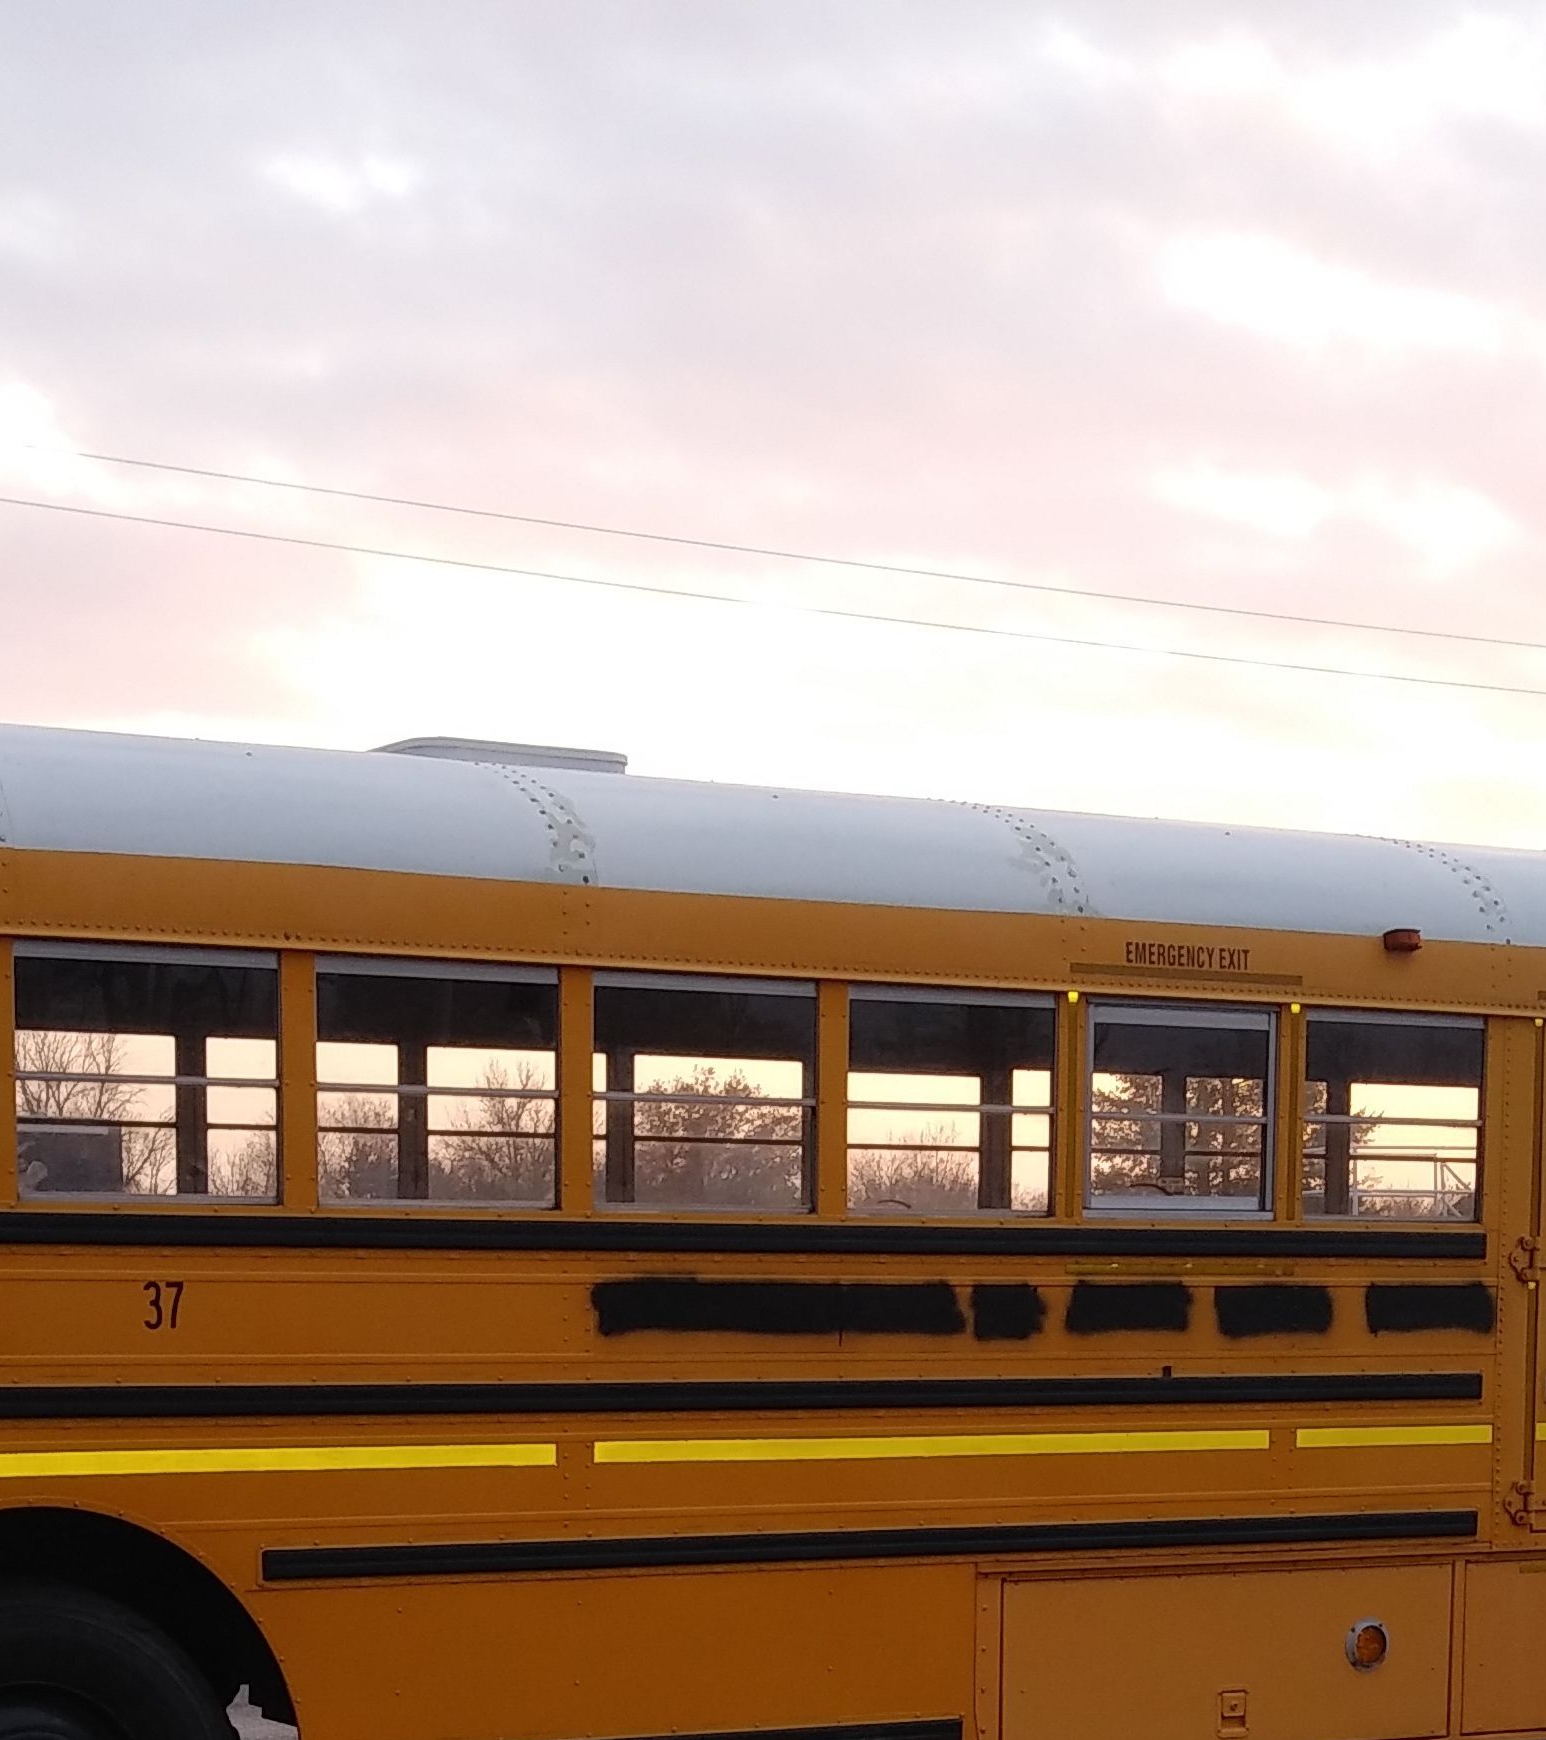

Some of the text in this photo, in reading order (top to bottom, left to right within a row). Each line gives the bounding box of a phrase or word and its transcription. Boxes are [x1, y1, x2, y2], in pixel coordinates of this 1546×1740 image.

[1125, 941, 1250, 971] EMERGENCY EXIT
[143, 1281, 184, 1330] 37
